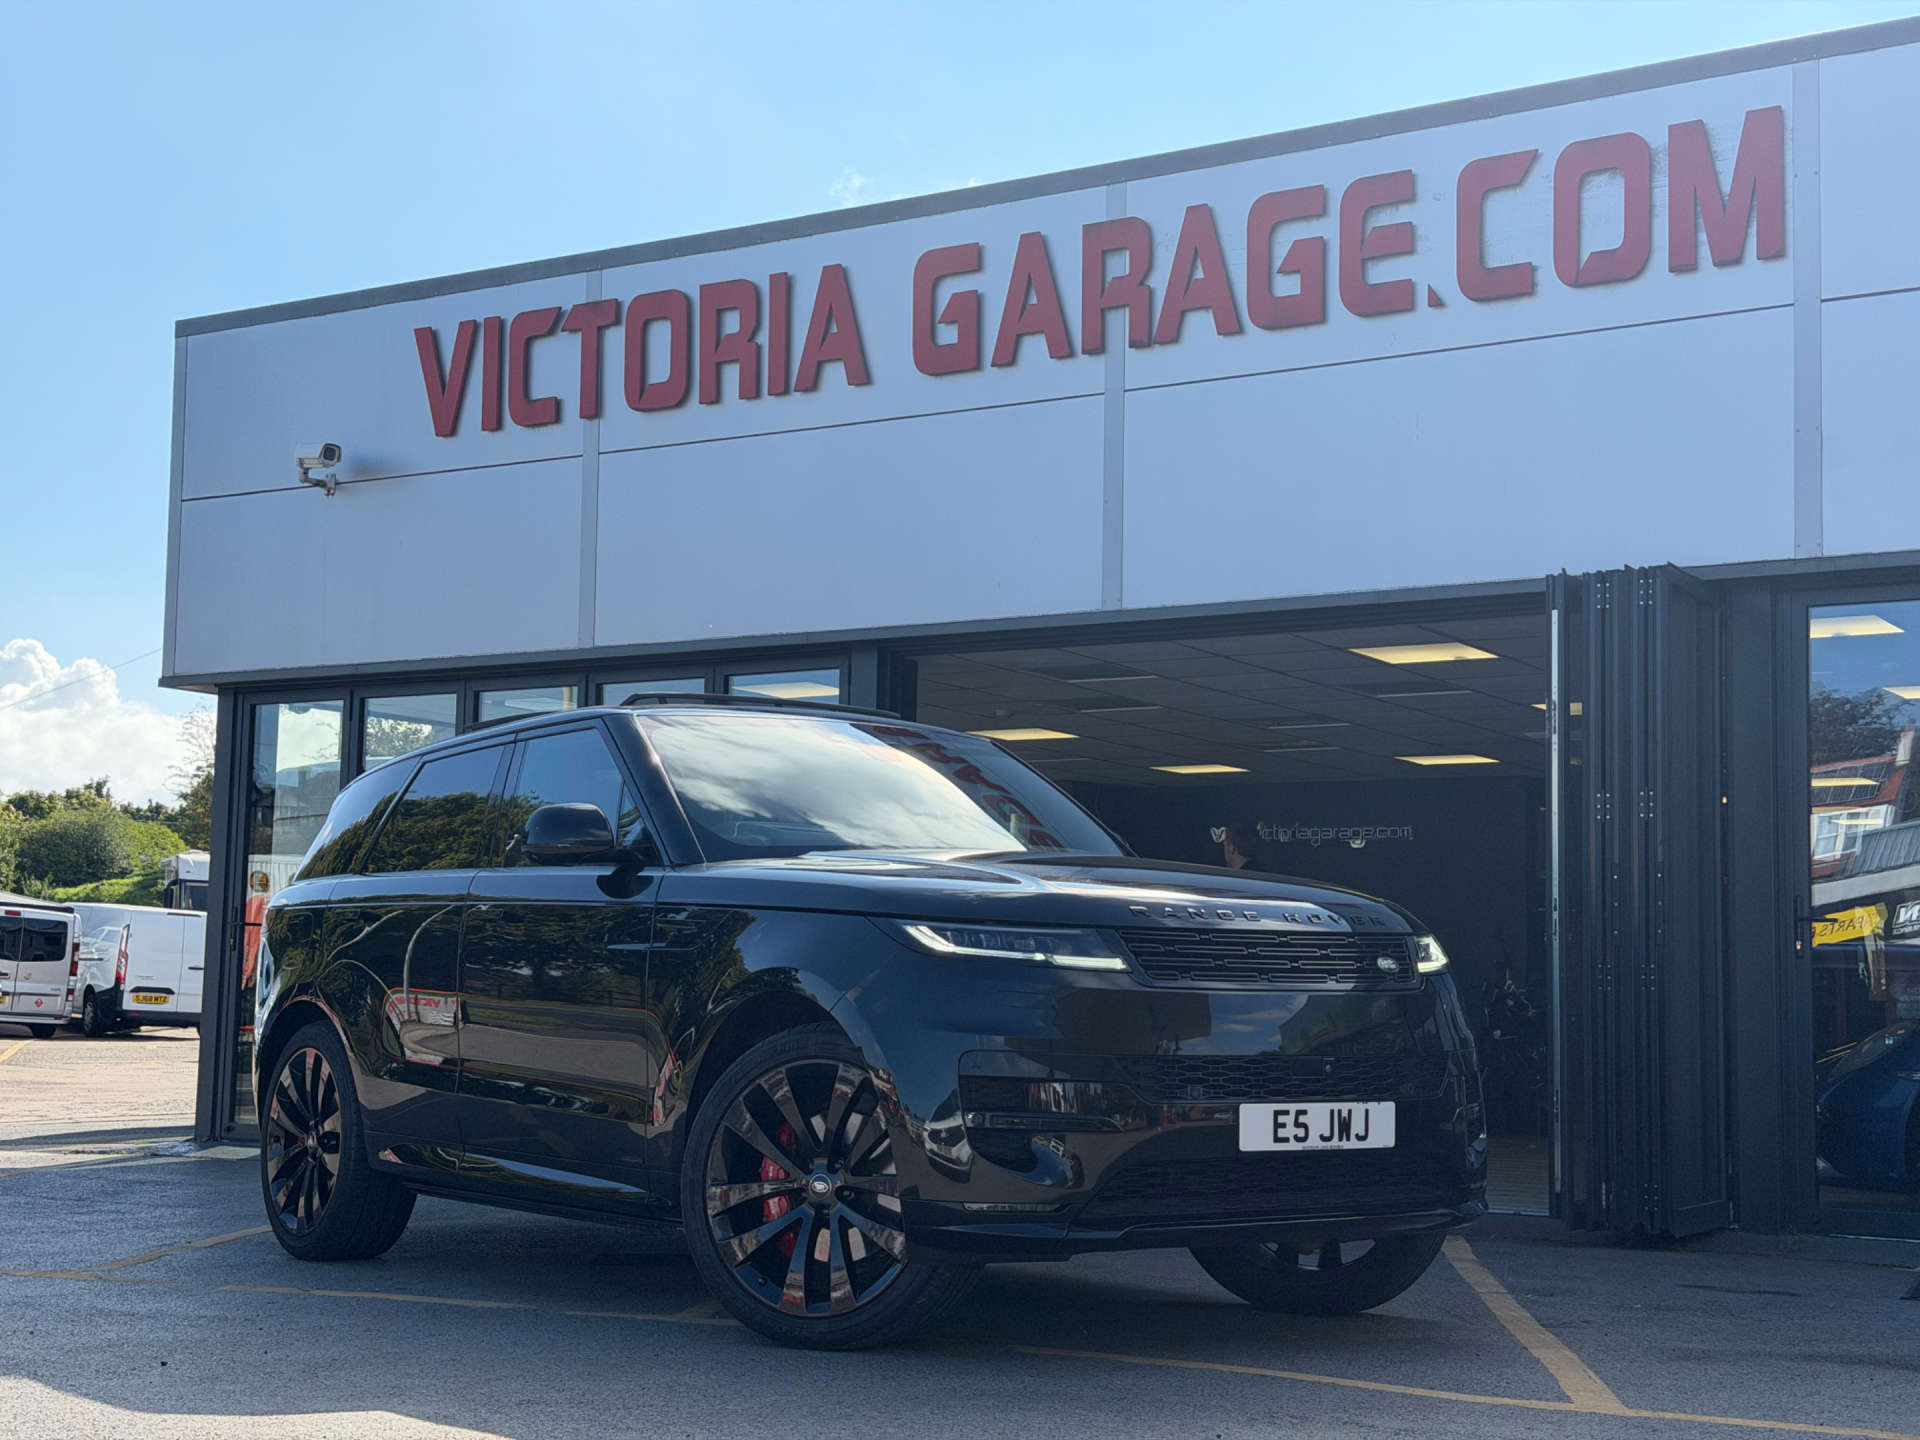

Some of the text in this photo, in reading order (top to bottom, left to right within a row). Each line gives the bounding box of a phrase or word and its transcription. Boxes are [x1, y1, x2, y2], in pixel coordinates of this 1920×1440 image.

[413, 104, 1786, 437] VICTORIA GARAGE.COM
[1128, 905, 1387, 927] RANGE ROVER
[1272, 1108, 1370, 1144] E5 JWJ
